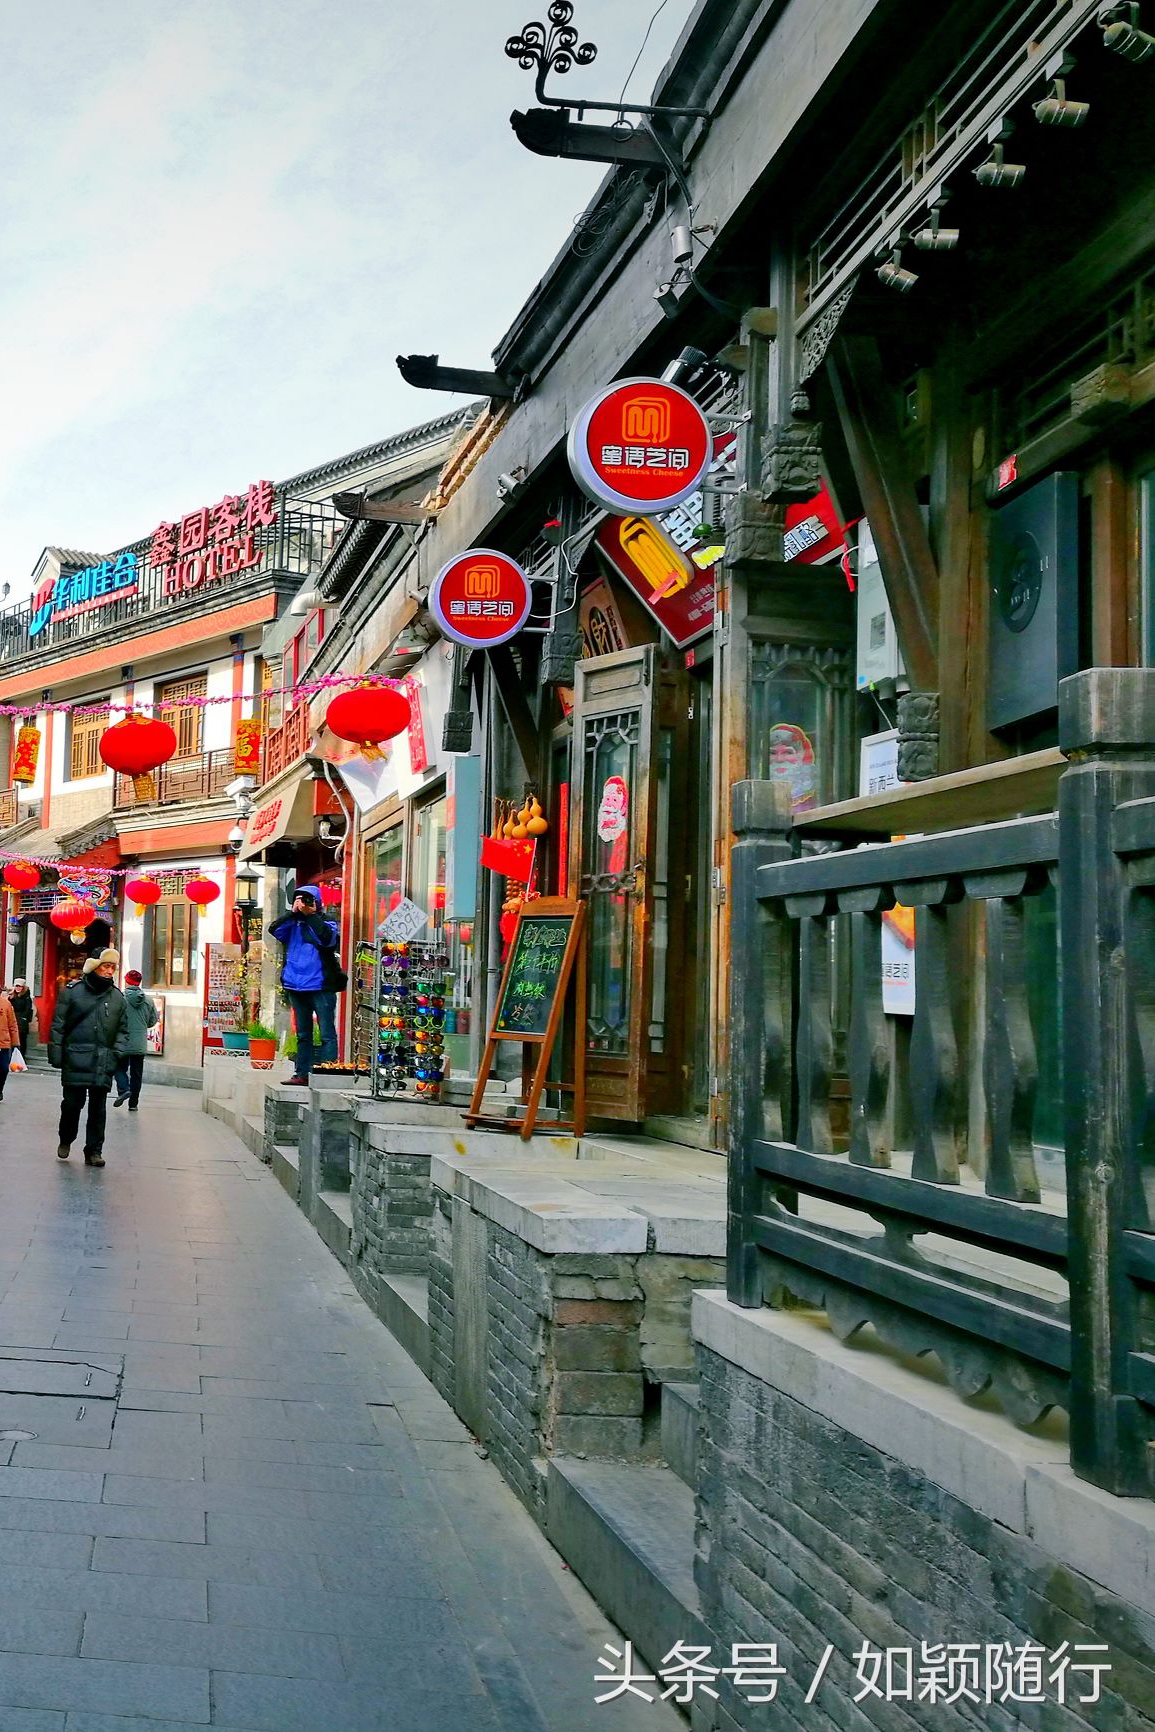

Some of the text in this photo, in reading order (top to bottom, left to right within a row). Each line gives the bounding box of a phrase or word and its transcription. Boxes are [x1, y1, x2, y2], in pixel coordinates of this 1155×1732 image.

[605, 466, 684, 477] Sweetness Cheese
[148, 480, 278, 569] 鑫园客栈
[51, 552, 139, 611] 华利佳合
[162, 534, 263, 597] HOTEL
